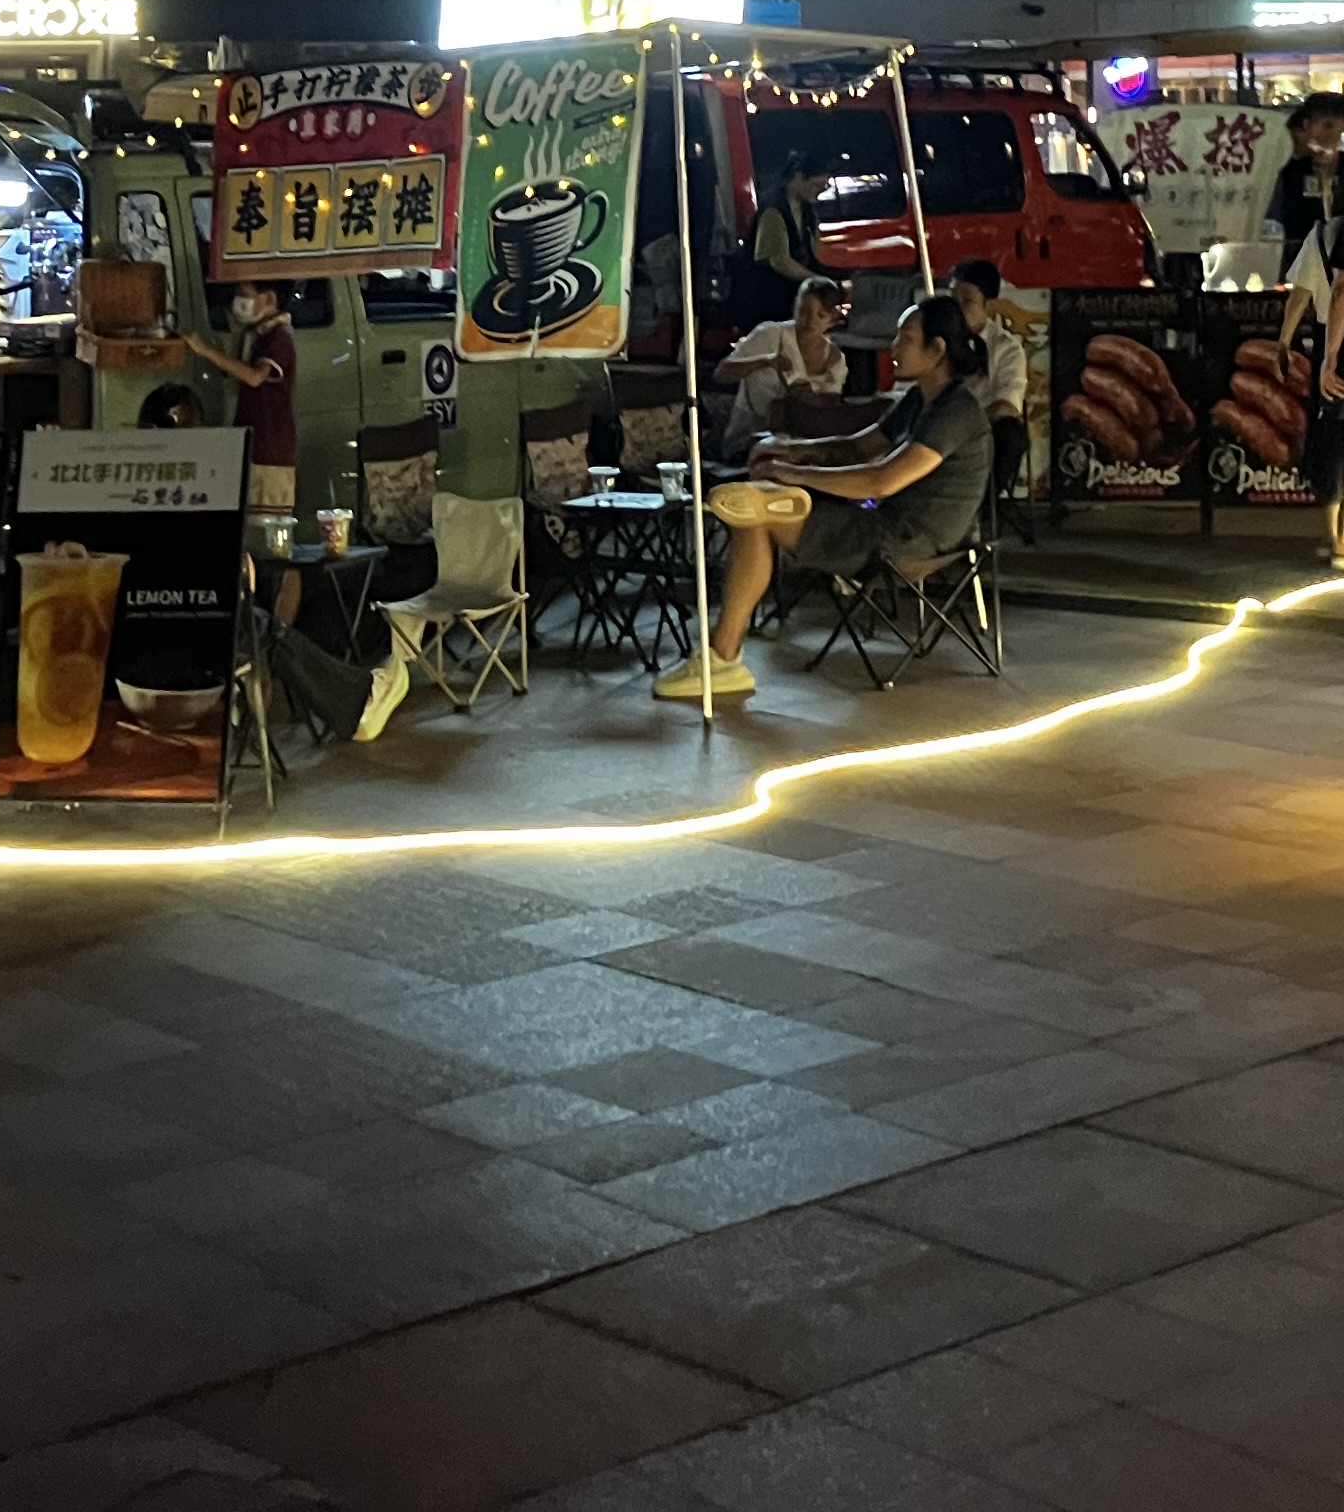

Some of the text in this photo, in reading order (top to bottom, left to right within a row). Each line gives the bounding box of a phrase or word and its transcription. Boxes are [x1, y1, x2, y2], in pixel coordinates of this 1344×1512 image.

[264, 65, 408, 110] 手打柠檬茶
[485, 59, 634, 128] Coffee
[232, 172, 435, 246] 奉旨摆摊
[1086, 460, 1182, 490] Delicious
[126, 589, 218, 606] LEMON TEA
